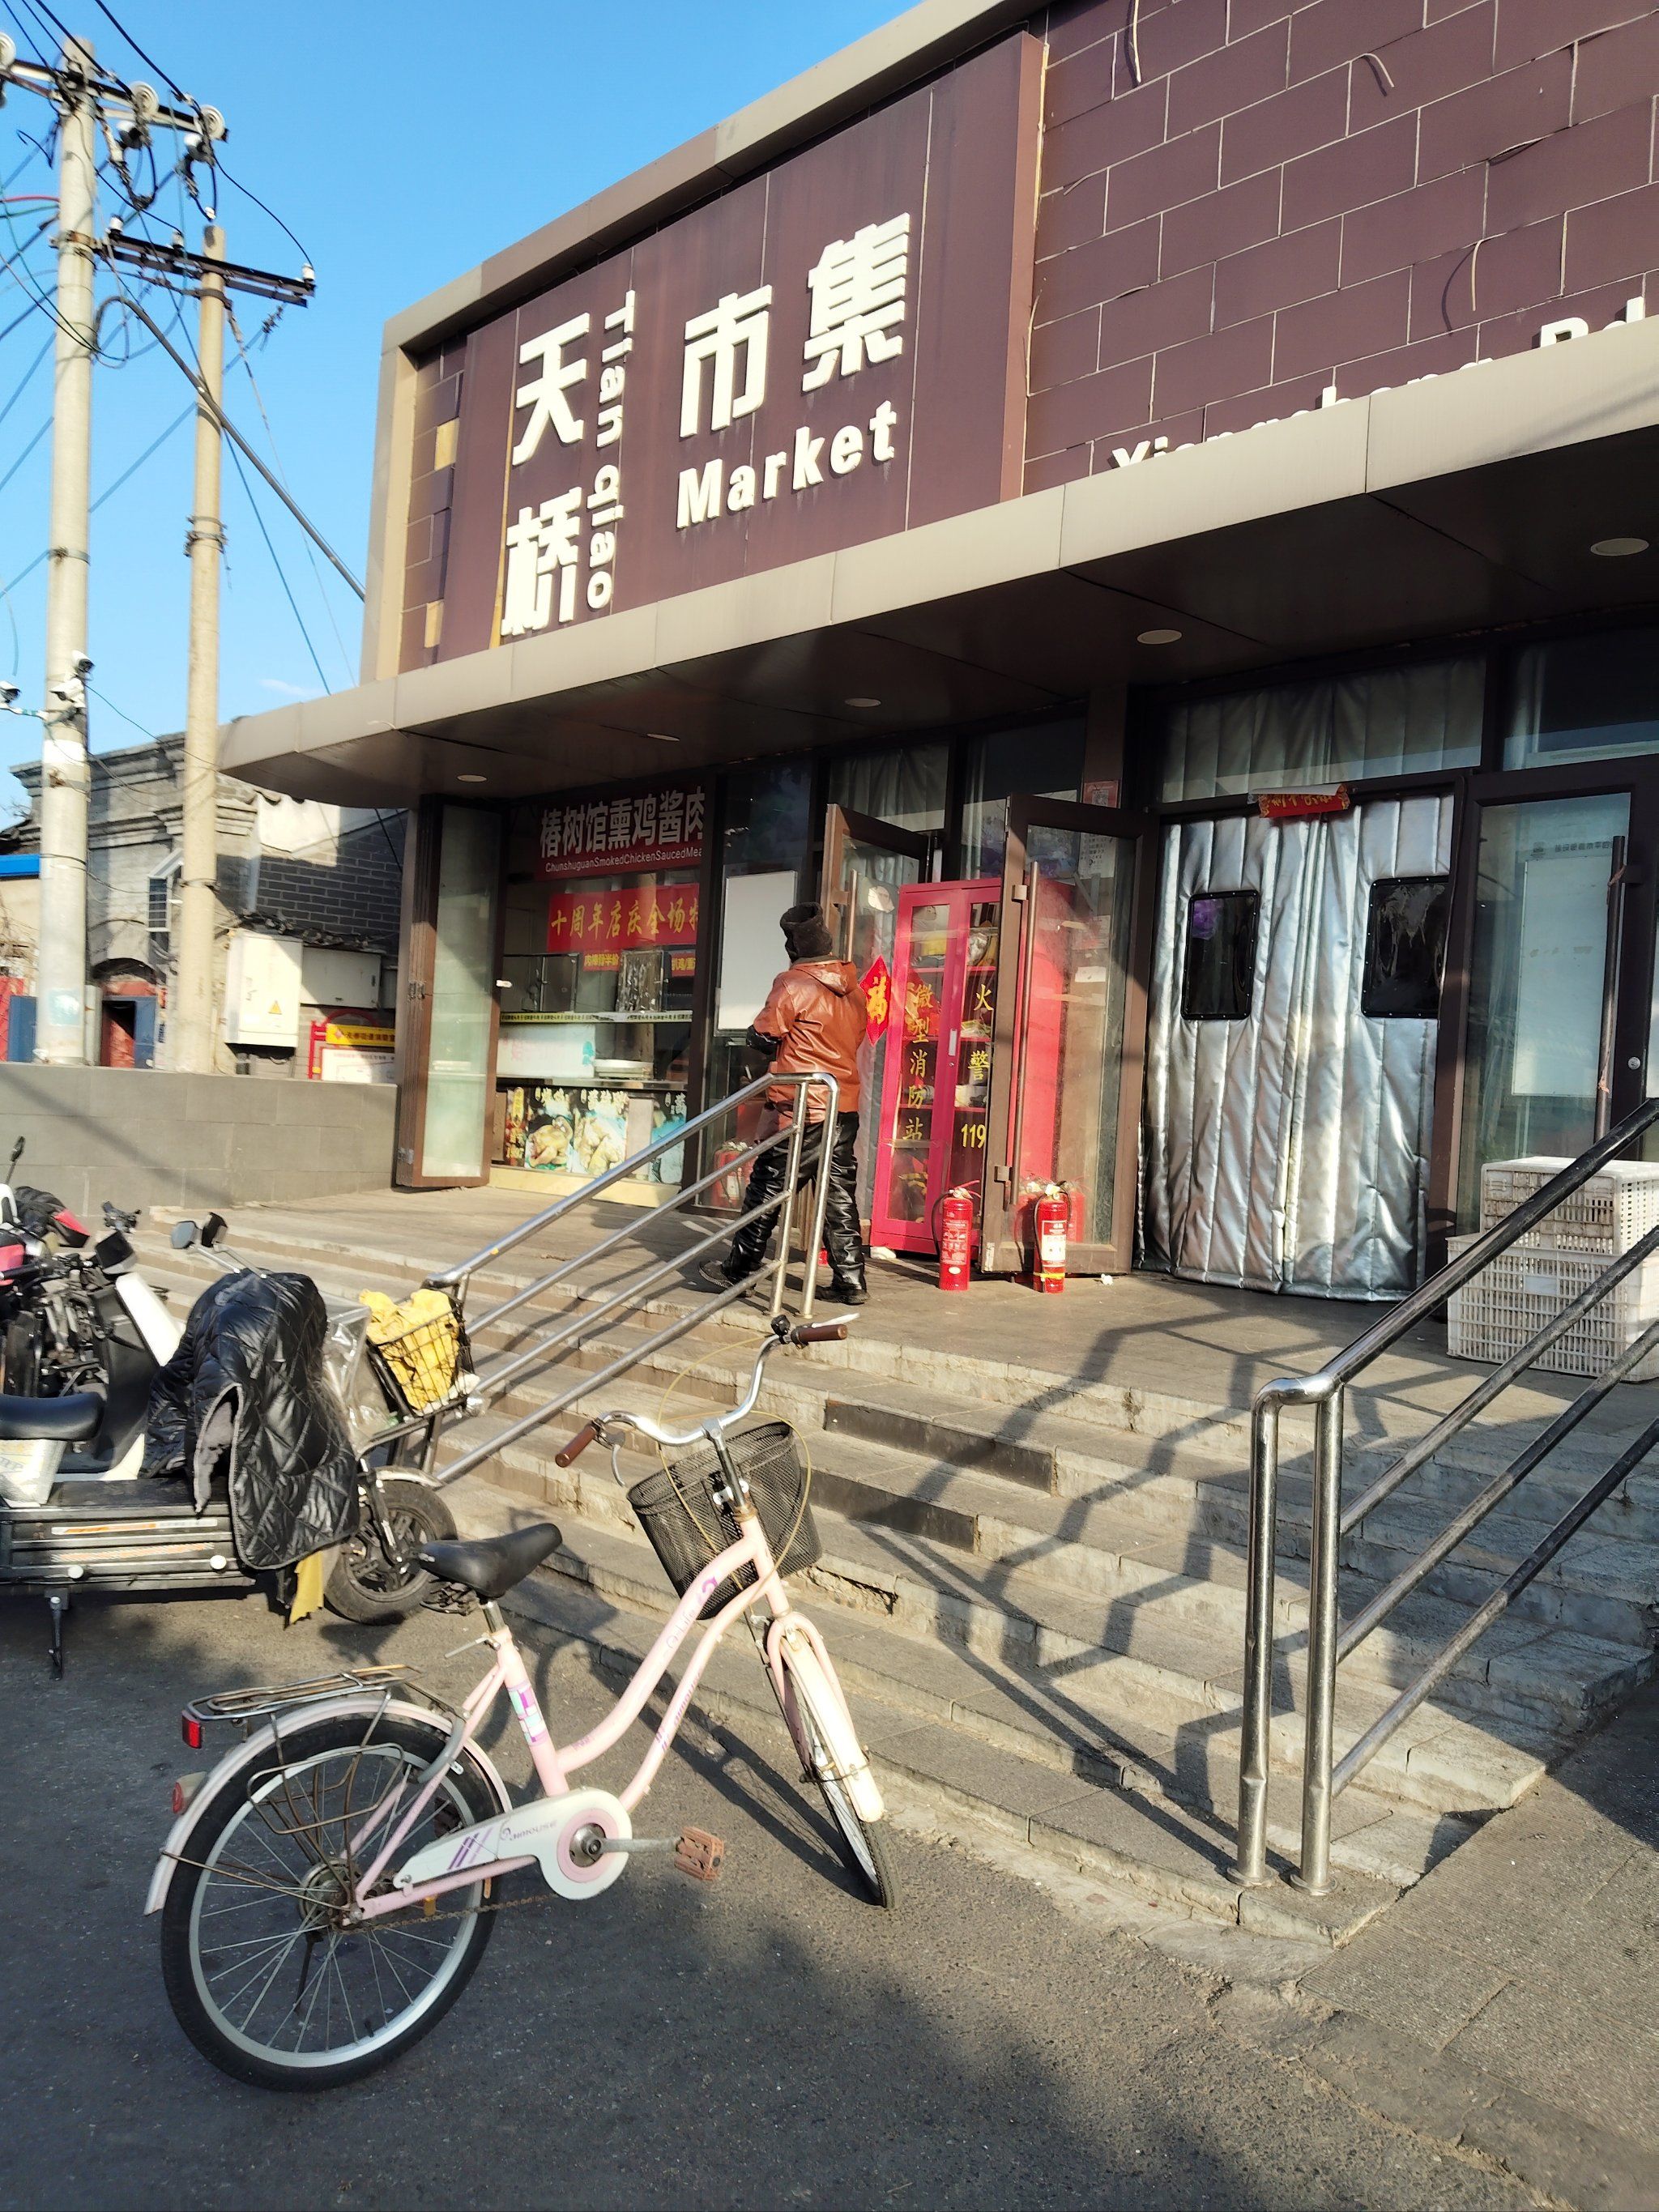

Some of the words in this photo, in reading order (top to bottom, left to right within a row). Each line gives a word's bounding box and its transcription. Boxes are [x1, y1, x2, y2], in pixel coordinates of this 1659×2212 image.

[596, 289, 636, 449] Tian
[679, 212, 911, 438] 市集
[501, 312, 590, 637] 天桥
[676, 399, 897, 530] Market
[902, 983, 934, 1141] 微型消防站
[961, 1123, 987, 1149] 119
